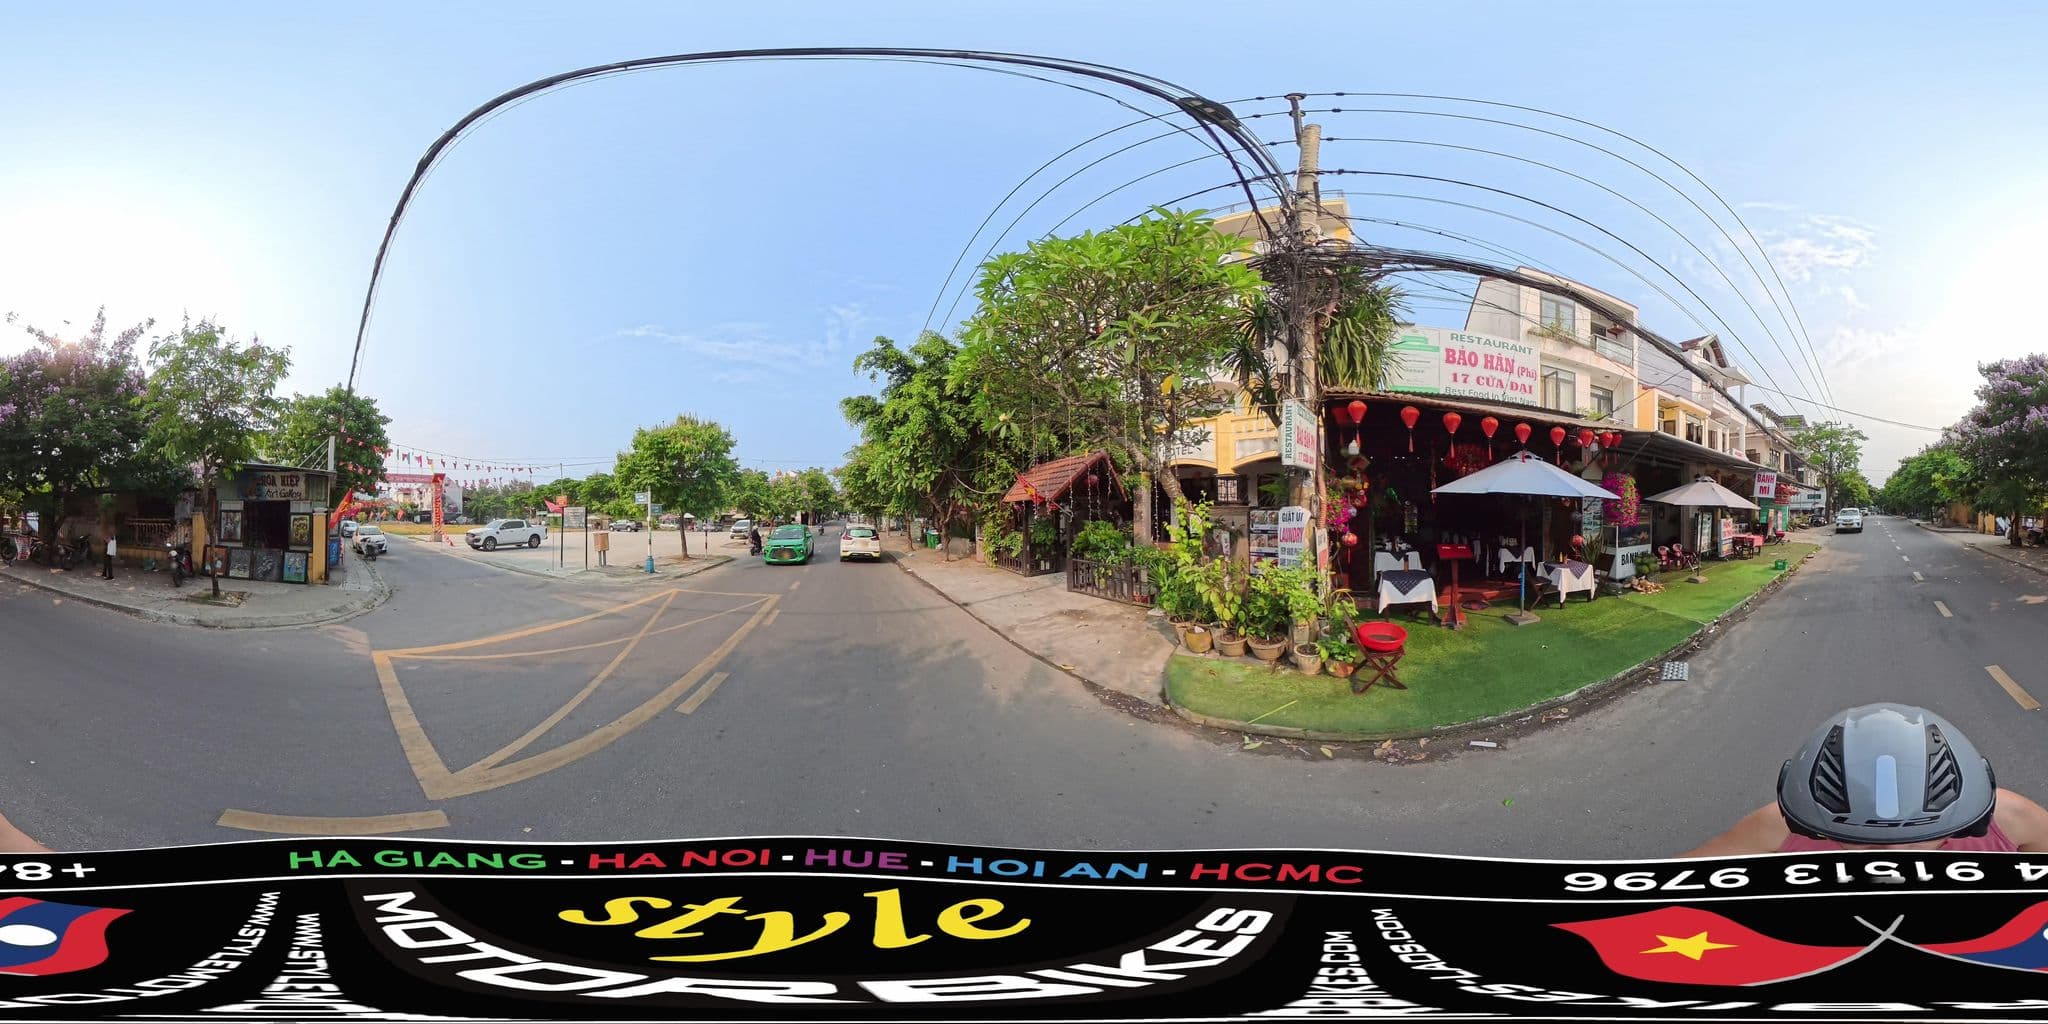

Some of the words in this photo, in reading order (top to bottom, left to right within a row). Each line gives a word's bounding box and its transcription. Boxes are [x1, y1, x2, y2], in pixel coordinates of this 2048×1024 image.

[1450, 333, 1533, 355] RESTAURANT
[1452, 372, 1470, 383] 17
[1445, 386, 1466, 396] Best
[1468, 389, 1490, 399] Food
[1285, 403, 1293, 459] RESTAURANT
[1832, 816, 1941, 827] LS2
